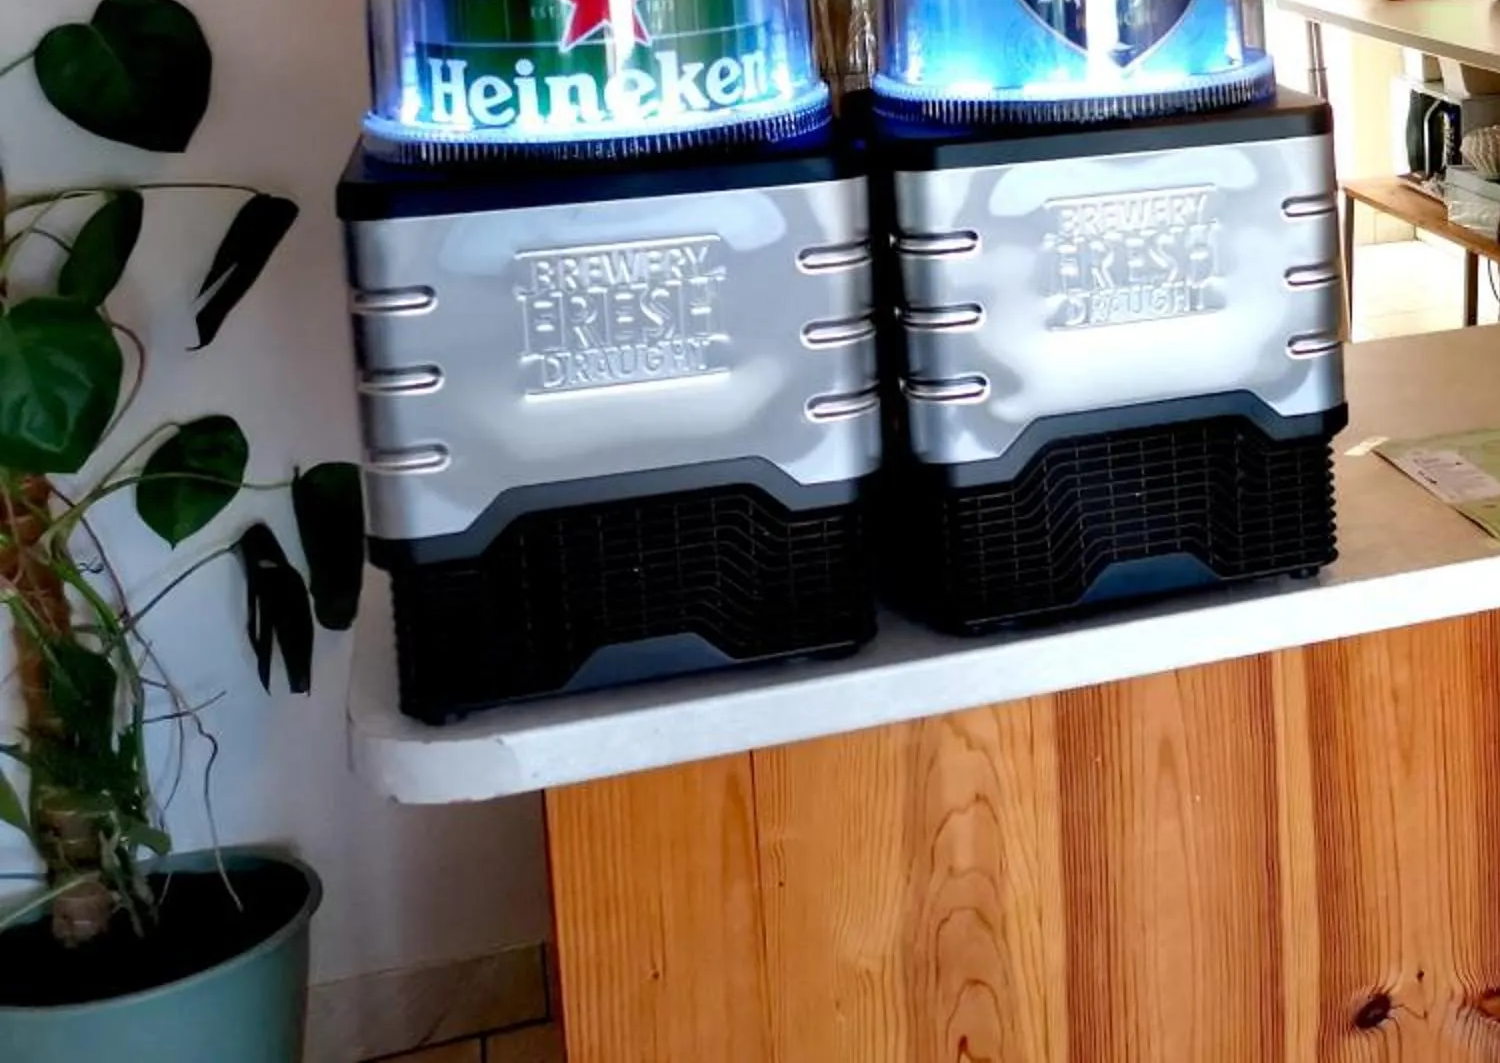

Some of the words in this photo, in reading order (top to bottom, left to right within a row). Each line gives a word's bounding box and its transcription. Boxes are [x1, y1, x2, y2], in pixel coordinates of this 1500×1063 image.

[427, 49, 768, 128] Heineken
[1059, 193, 1208, 236] BREWERY
[532, 245, 709, 291] BREWERY
